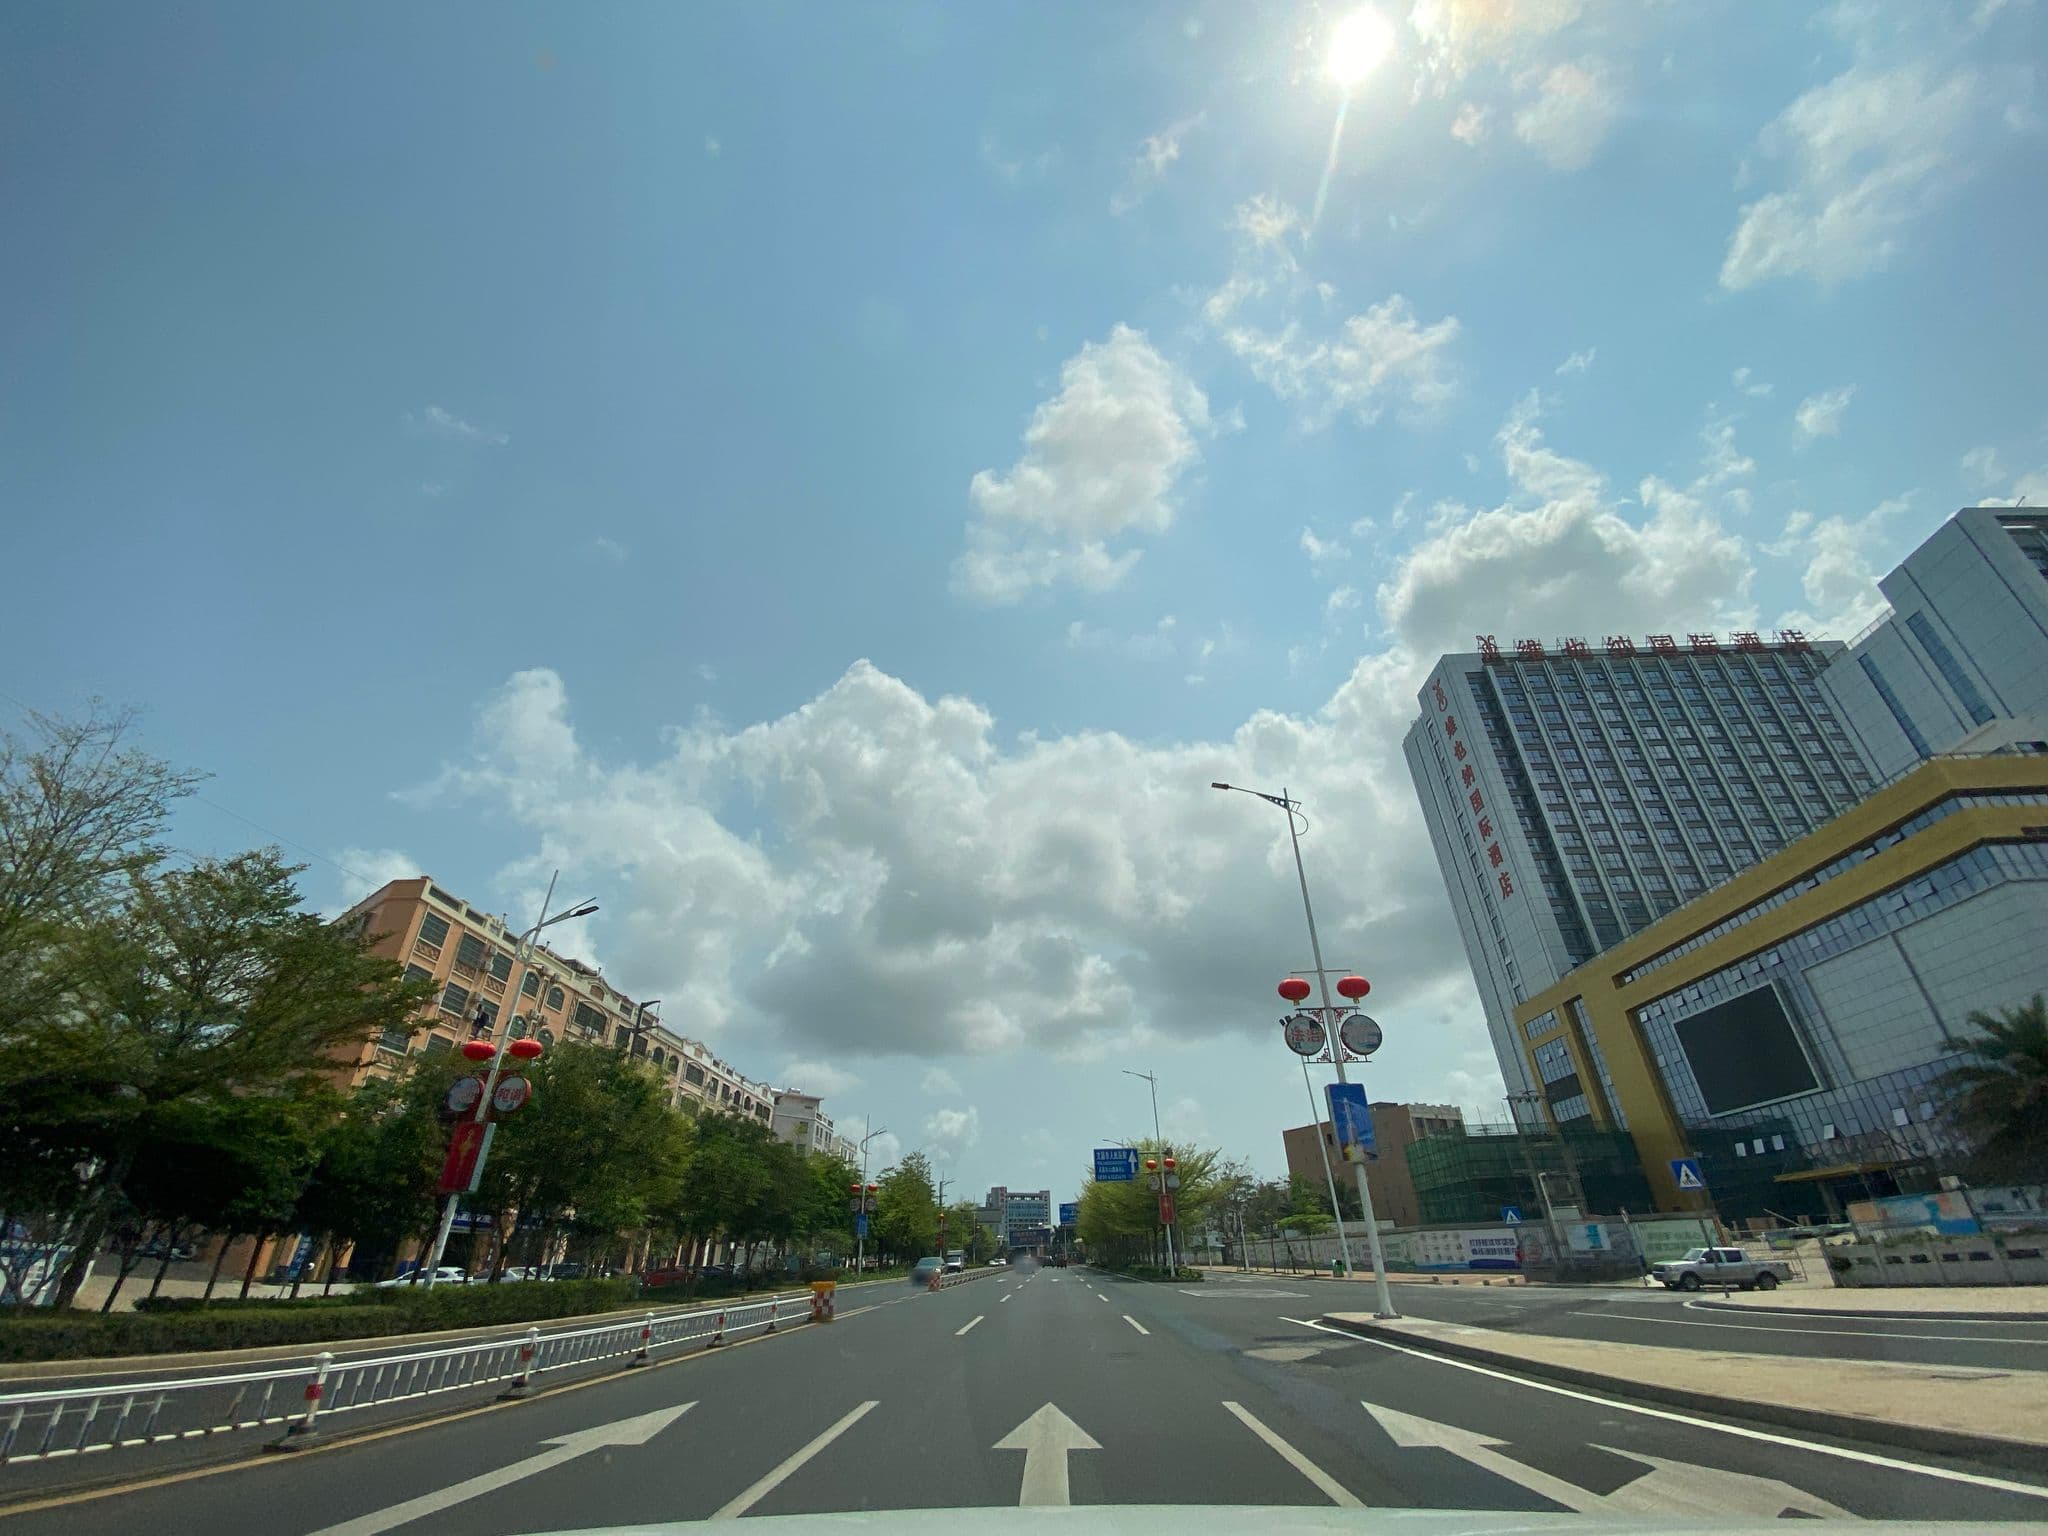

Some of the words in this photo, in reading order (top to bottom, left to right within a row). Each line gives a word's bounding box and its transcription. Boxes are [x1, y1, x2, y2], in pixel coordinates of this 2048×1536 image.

[1514, 629, 1813, 663] 维也纳国际酒店
[1444, 714, 1514, 900] 维也纳国际酒店
